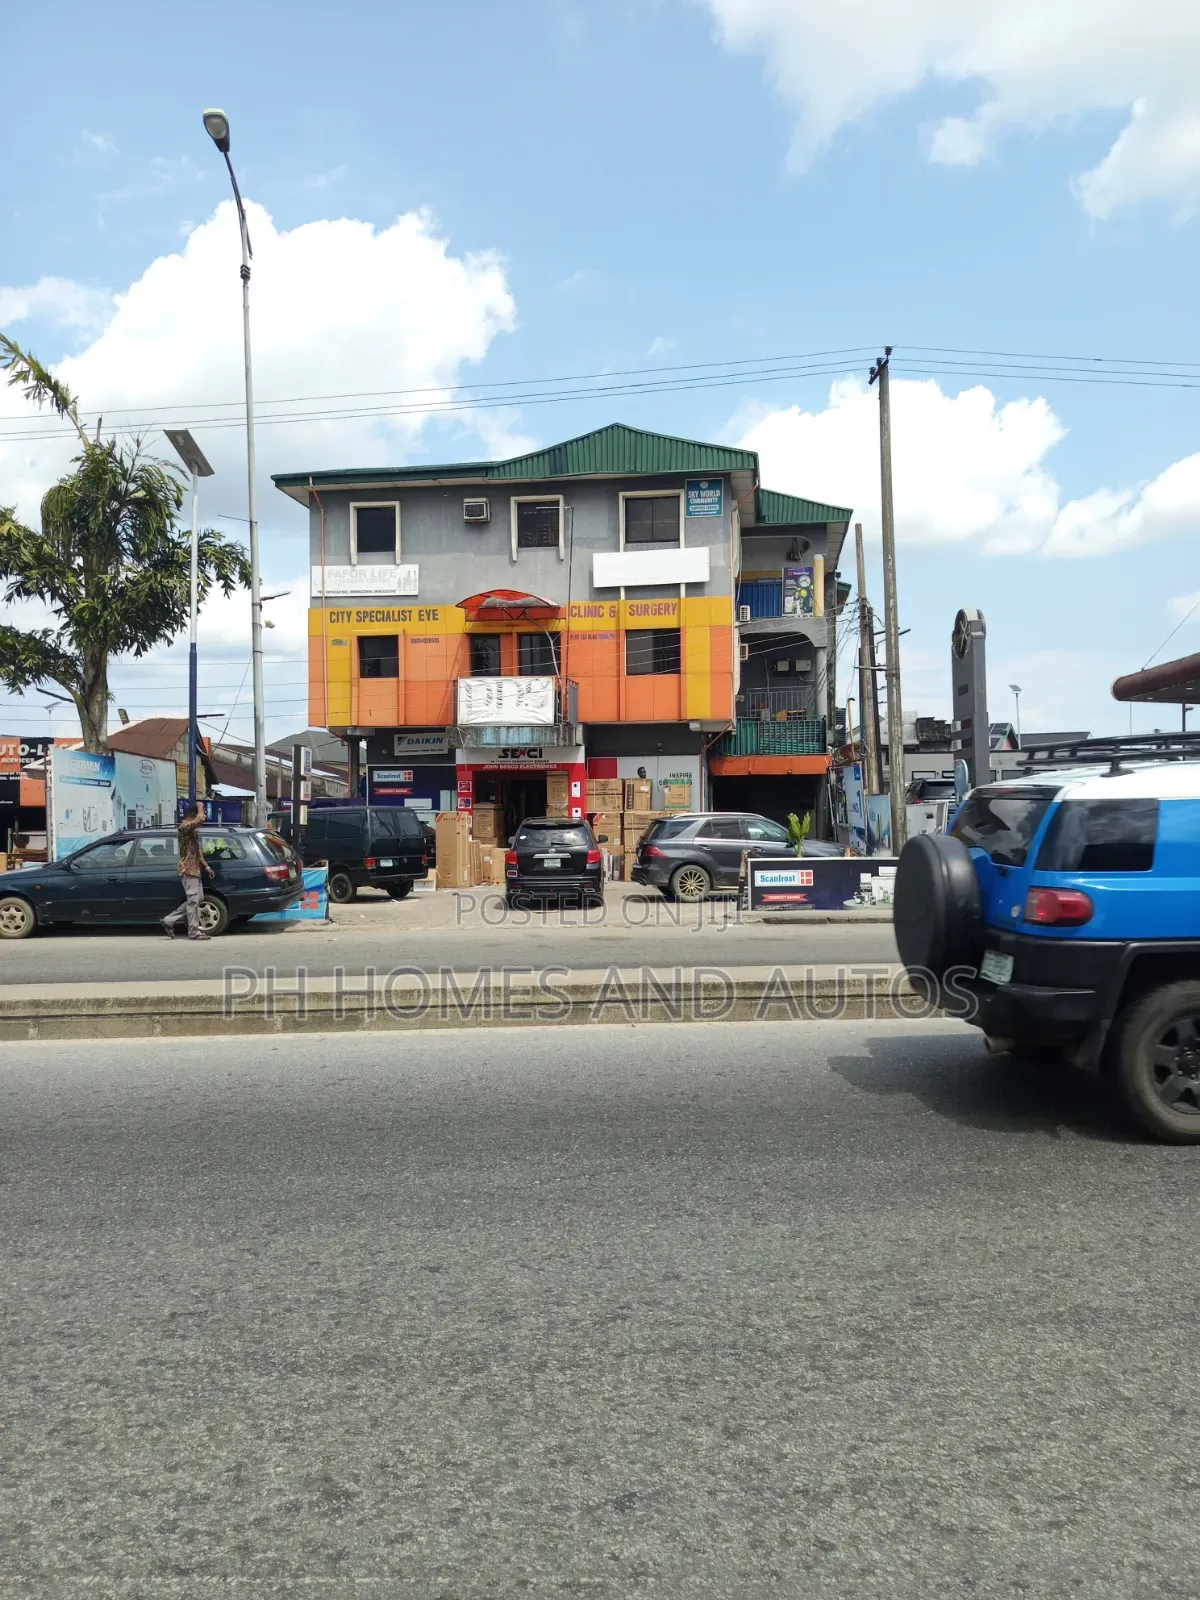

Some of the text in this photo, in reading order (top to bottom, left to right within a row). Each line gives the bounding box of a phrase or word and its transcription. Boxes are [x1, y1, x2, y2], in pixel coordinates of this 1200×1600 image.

[371, 568, 397, 578] LIFE
[329, 609, 438, 623] CITY SPECIALIST EYE
[570, 603, 677, 618] CLINIC & SURGERY
[498, 748, 542, 758] SENCI
